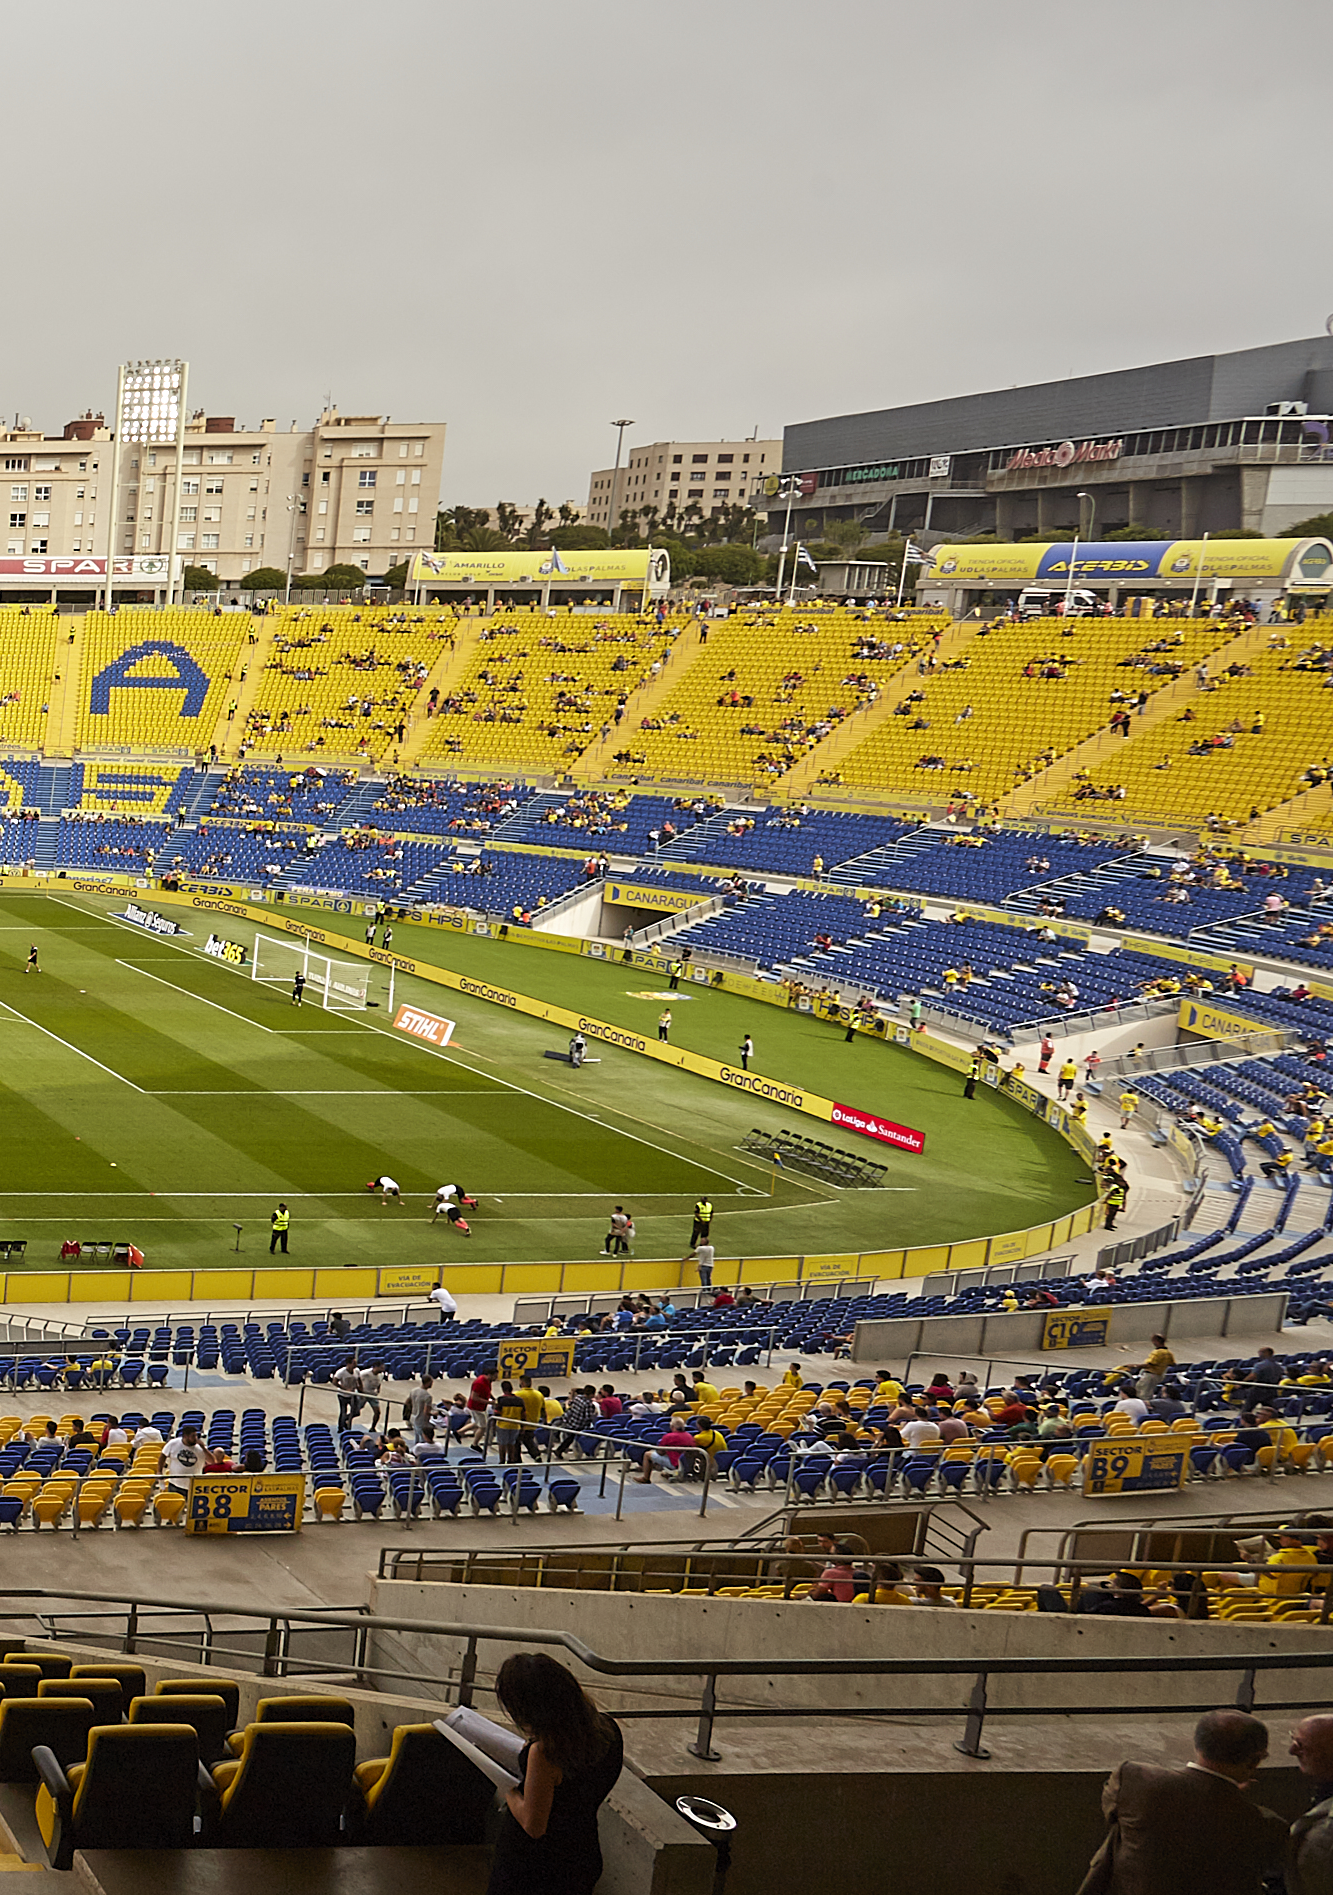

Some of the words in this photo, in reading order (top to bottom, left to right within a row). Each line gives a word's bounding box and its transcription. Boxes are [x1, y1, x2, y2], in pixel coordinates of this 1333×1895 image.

[1007, 448, 1057, 470] Media
[1071, 438, 1124, 463] Markt
[845, 465, 900, 482] MERCADONA
[23, 559, 132, 573] SPAR
[453, 562, 505, 570] AMARILLO
[967, 557, 994, 566] TIENDA
[995, 557, 1026, 566] OFICIAL
[1047, 557, 1151, 574] ACERBIS
[1204, 555, 1230, 563] TIENDA
[1232, 553, 1270, 563] OFICIAL
[740, 606, 783, 614] canaribat
[791, 606, 835, 615] canaribat
[660, 776, 705, 786] canaribat
[706, 780, 753, 790] canaribat
[73, 880, 139, 898] GranCanaria
[178, 882, 234, 897] CERBIS
[812, 884, 844, 895] SPAR
[192, 897, 248, 917] GranCanaria
[288, 895, 334, 909] SPAR
[626, 890, 701, 911] CANARAGUA
[124, 903, 148, 927] Allianz
[153, 911, 182, 936] Seguros
[429, 913, 464, 929] HPS
[285, 920, 326, 942] GranCanaria
[205, 933, 247, 965] bet365
[368, 947, 416, 973] GranCanaria
[459, 977, 517, 1007] GranCanaria
[398, 1010, 439, 1041] STIHL
[578, 1017, 646, 1053] GranCanaria
[719, 1066, 803, 1108] GranCanaria
[1008, 1079, 1038, 1108] SPAR
[841, 1113, 866, 1129] LaLiga
[878, 1123, 921, 1148] Santander
[387, 1280, 431, 1289] EVACUACIÓN
[1047, 1321, 1079, 1339] C10
[501, 1352, 528, 1370] C9
[1096, 1446, 1143, 1457] SECTOR
[1090, 1455, 1130, 1481] B9
[194, 1485, 248, 1494] SECTOR
[191, 1494, 232, 1519] B8
[258, 1503, 286, 1512] PARES
